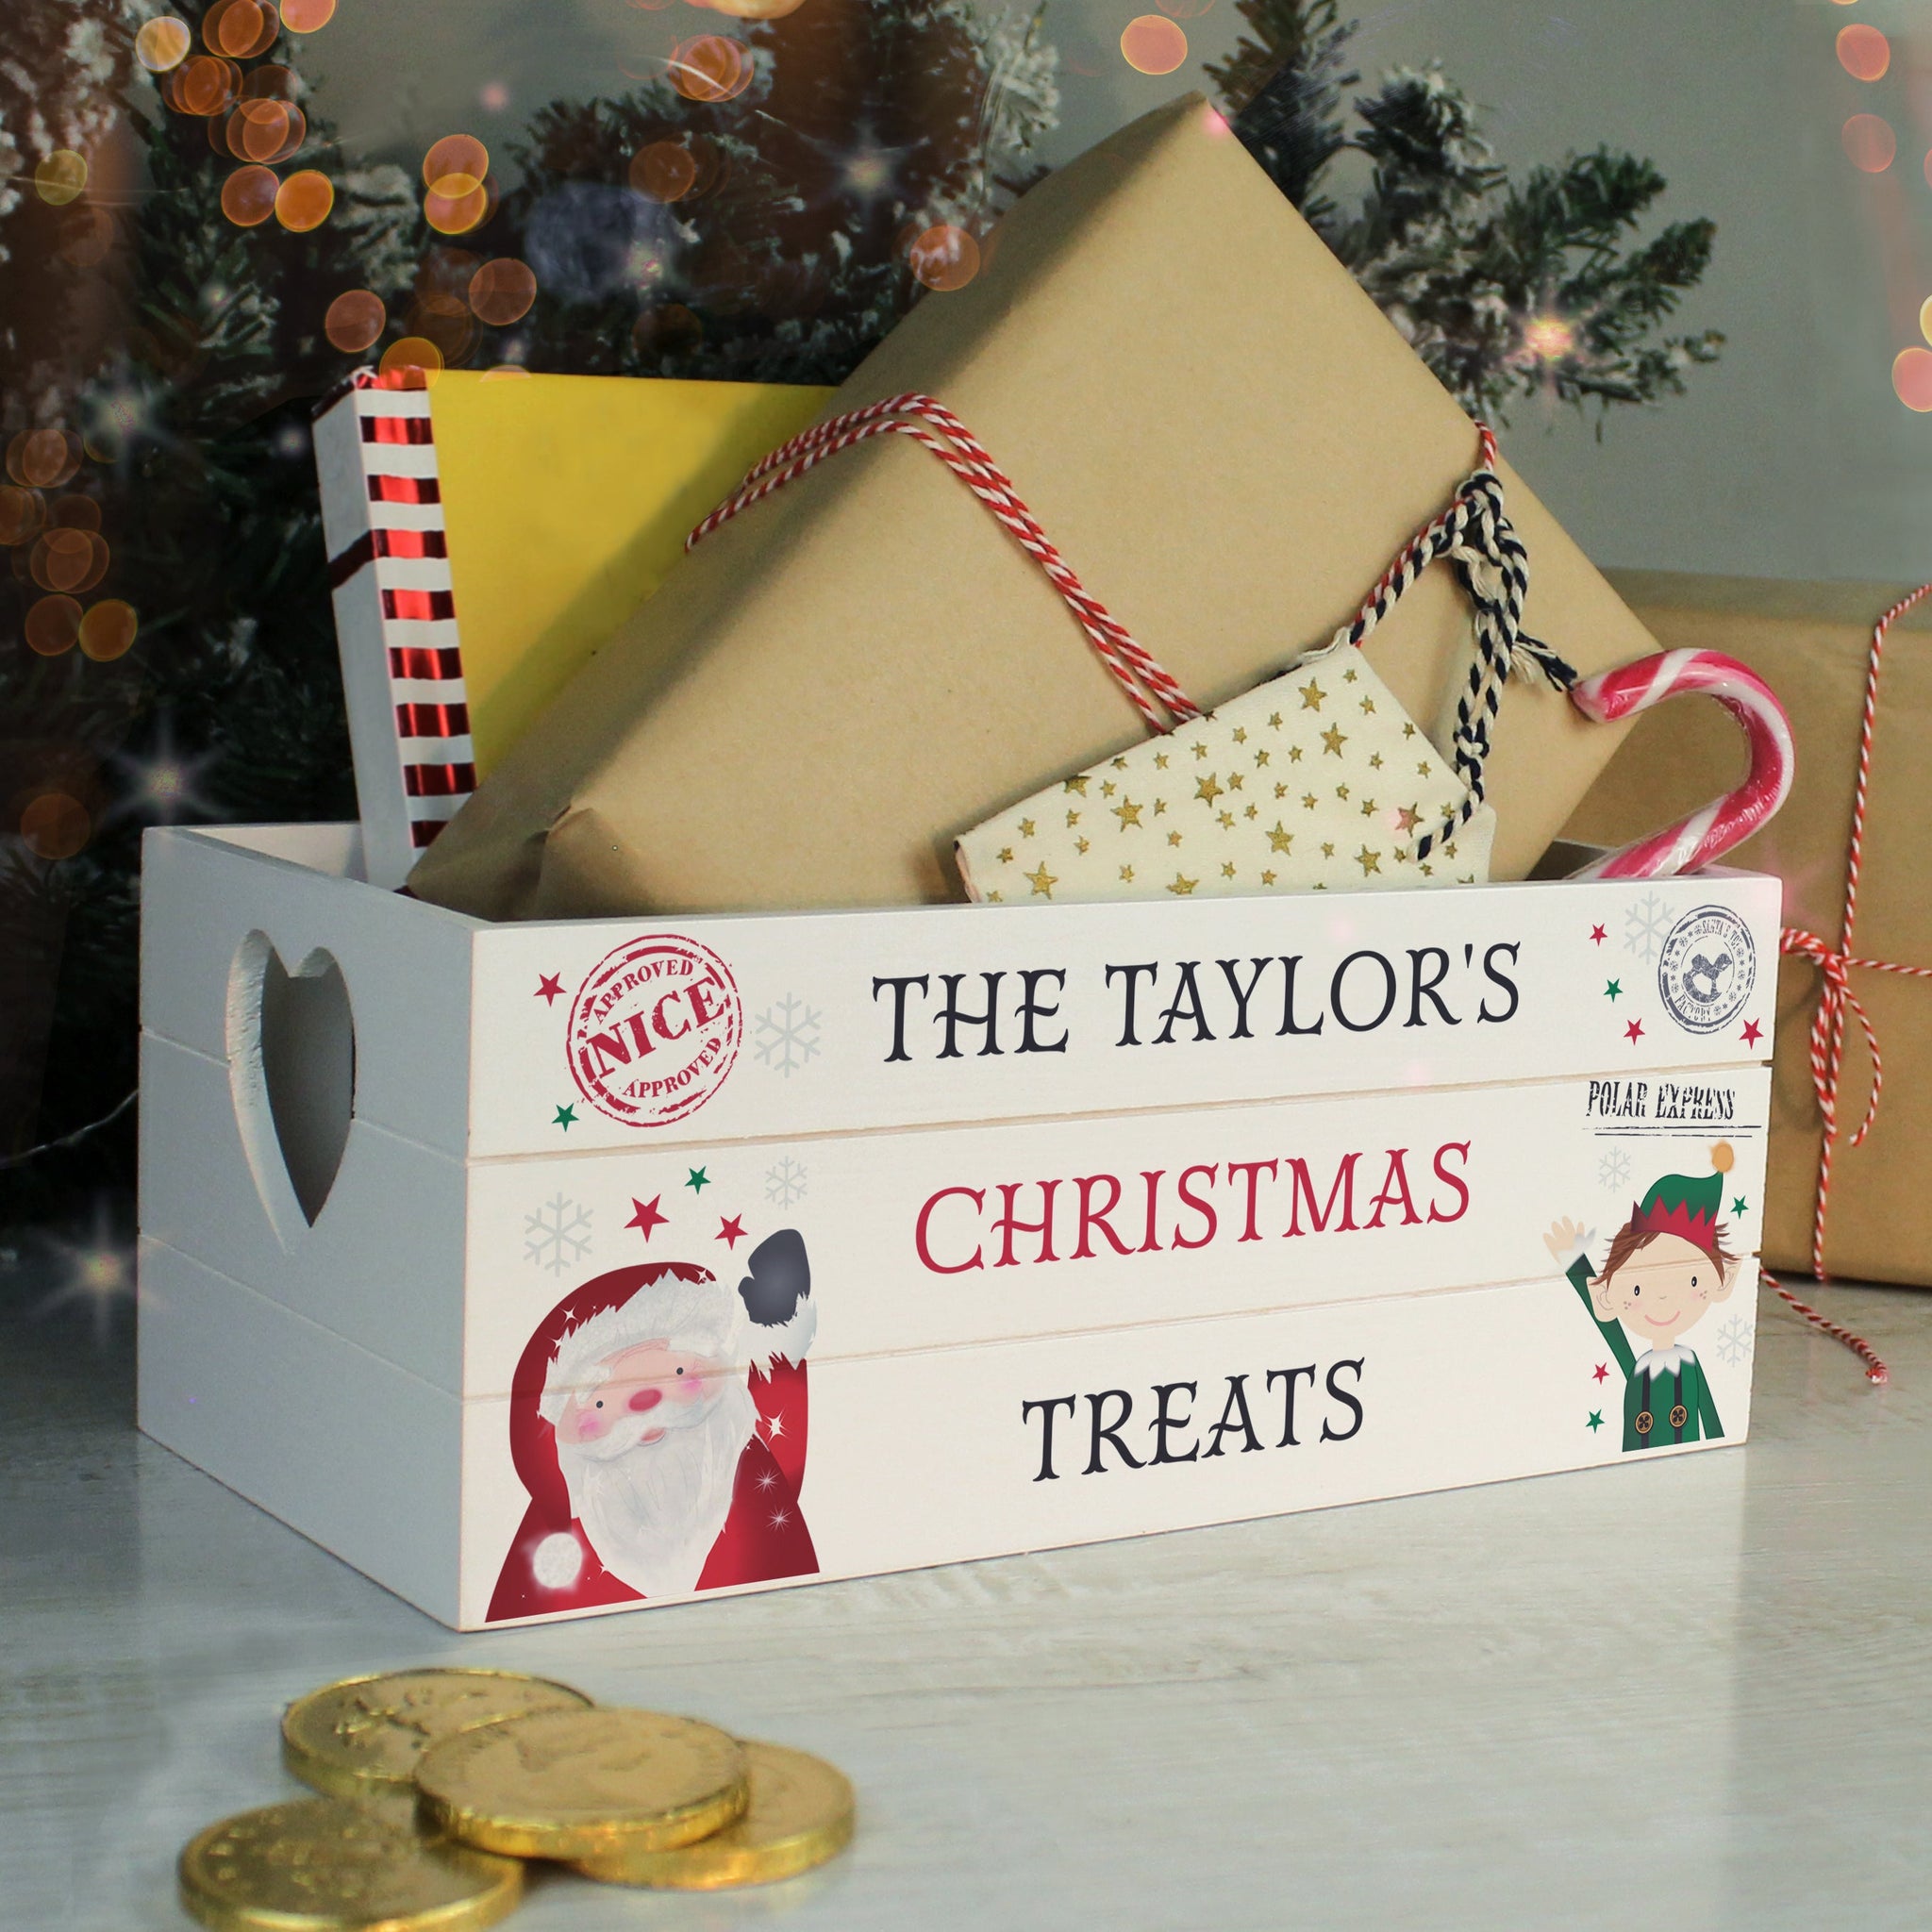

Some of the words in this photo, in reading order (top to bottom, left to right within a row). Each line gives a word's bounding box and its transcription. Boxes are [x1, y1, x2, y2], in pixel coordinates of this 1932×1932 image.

[586, 976, 725, 1079] NICE
[593, 958, 694, 1024] APPROVED
[873, 968, 1069, 1063] THE
[1106, 941, 1521, 1047] TAYLOR'S
[623, 1038, 722, 1098] APPROVED
[1586, 1080, 1648, 1118] POLAR
[1656, 1083, 1735, 1120] EXPRESS
[914, 1141, 1471, 1274] CHRISTMAS
[1023, 1357, 1365, 1482] TREATS
